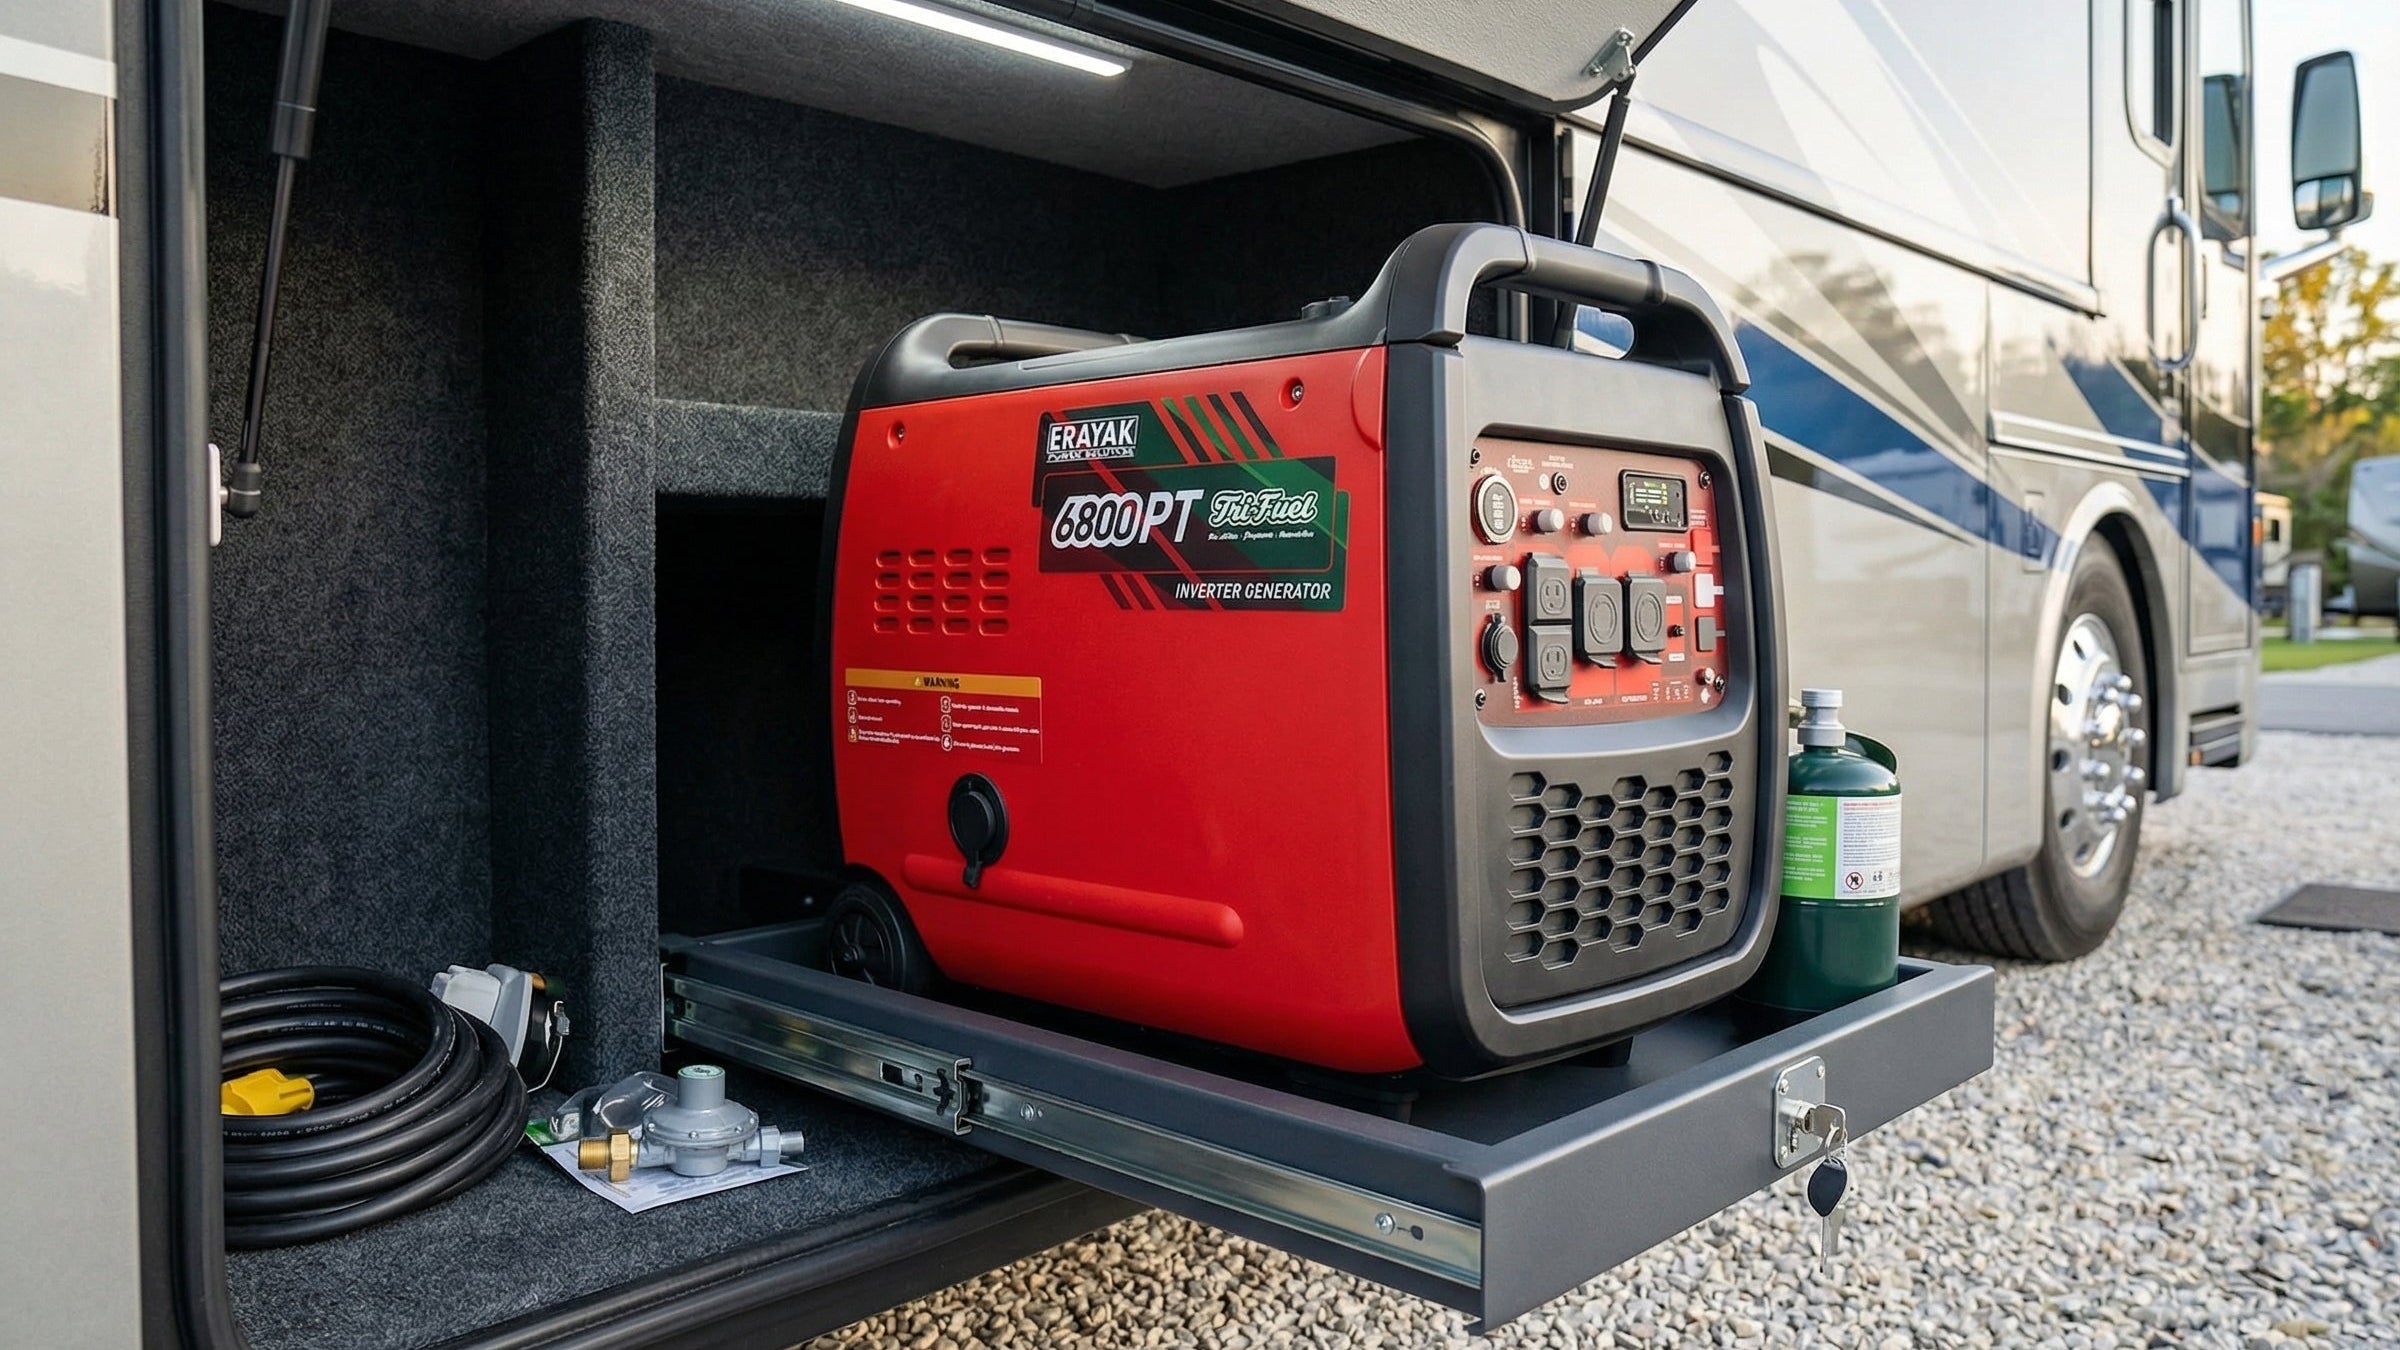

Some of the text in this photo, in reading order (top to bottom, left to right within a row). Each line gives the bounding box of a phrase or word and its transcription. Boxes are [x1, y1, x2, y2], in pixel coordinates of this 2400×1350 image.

[1049, 419, 1136, 451] ERAYAK
[1051, 488, 1205, 549] 6800PT
[1175, 582, 1332, 599] INVERTER GENERATOR
